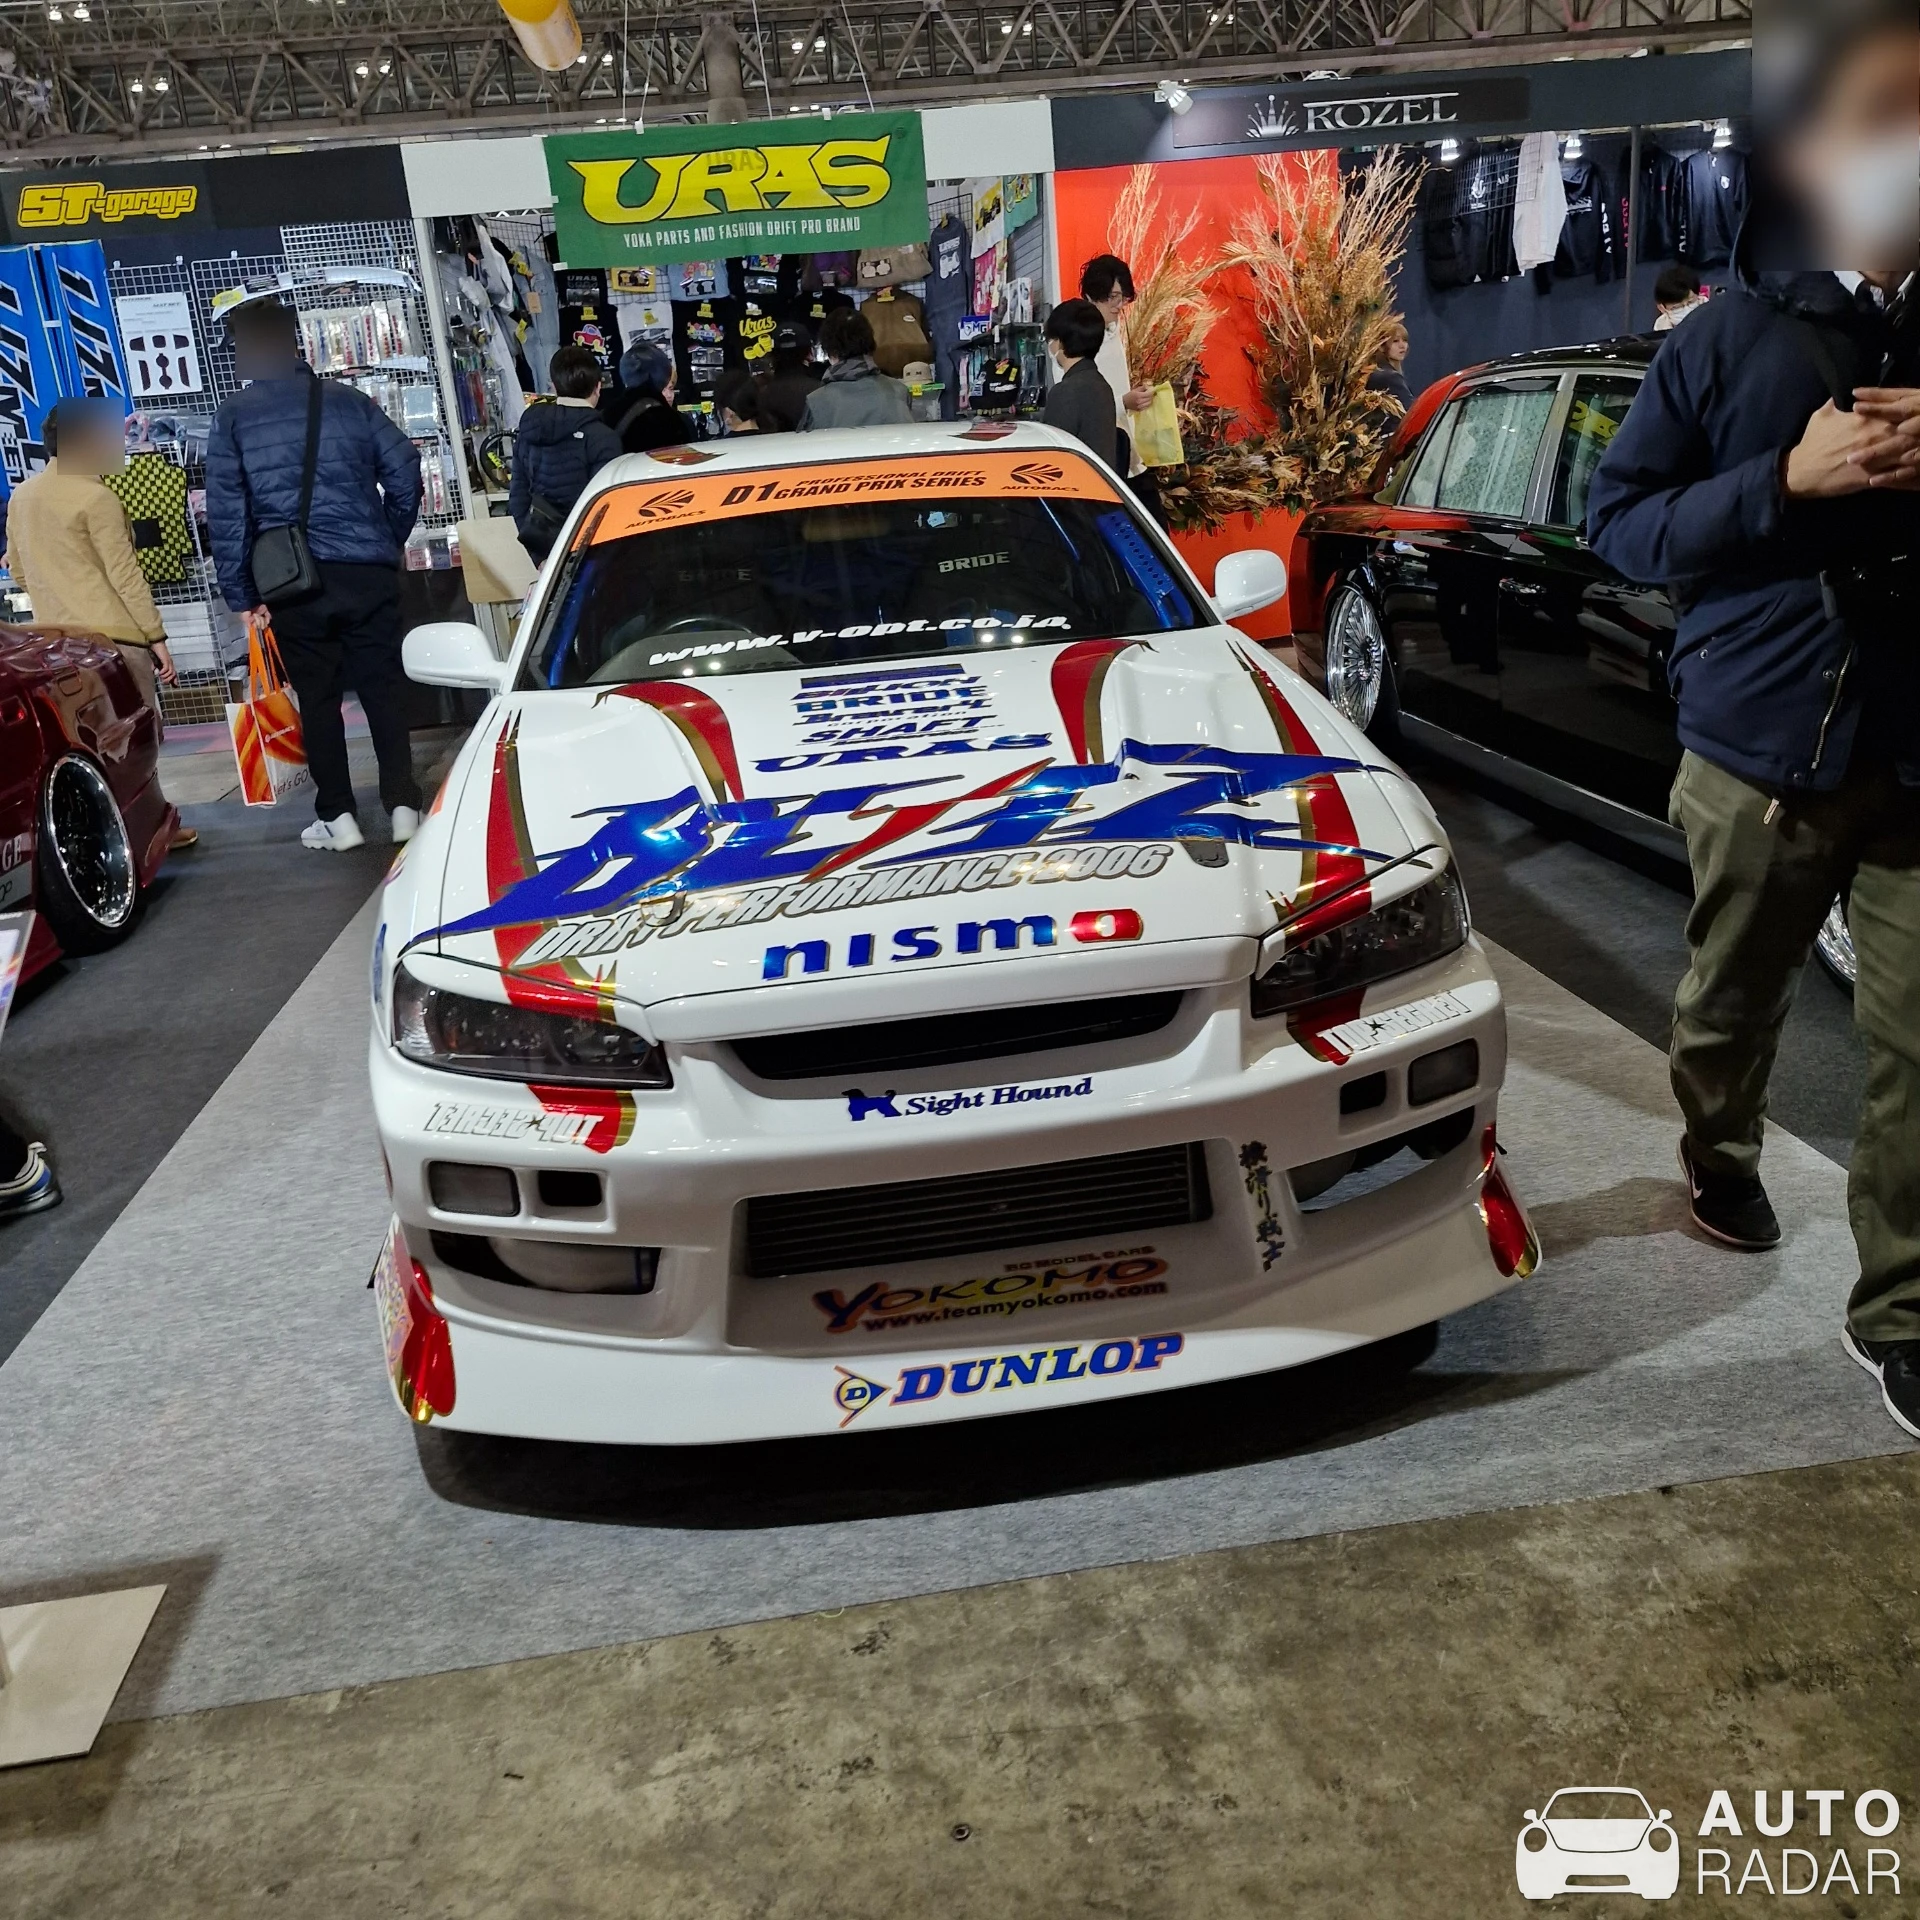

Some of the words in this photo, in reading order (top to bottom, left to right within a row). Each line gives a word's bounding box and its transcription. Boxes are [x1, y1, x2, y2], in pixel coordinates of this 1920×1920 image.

[1306, 94, 1458, 132] ROZEL
[567, 135, 894, 224] URAS
[18, 182, 198, 228] ST-garage
[623, 232, 653, 248] YOKA
[656, 229, 690, 246] PARTS
[694, 226, 716, 243] AND
[718, 222, 763, 240] FASHION
[766, 220, 797, 236] DRIFT
[801, 218, 822, 235] PRO
[826, 216, 861, 233] BRAND
[738, 315, 777, 339] Uras
[719, 481, 781, 507] D1
[773, 482, 851, 500] GRAND
[853, 477, 907, 493] PRIX
[910, 476, 988, 489] SERIES
[796, 470, 926, 487] PROFESSIONAL
[931, 469, 985, 478] DRIFT
[1000, 484, 1080, 493] AUTOBACS
[624, 509, 707, 530] AUTOBACS
[938, 551, 1011, 574] BRIDE
[791, 685, 988, 713] BRIDE
[801, 715, 999, 743] SHAFT
[749, 732, 1053, 773] URAS
[657, 850, 1040, 940] PERFORMANCE
[1025, 843, 1174, 884] 2006
[762, 908, 1144, 981] nismo
[905, 1091, 985, 1117] Sight
[991, 1076, 1094, 1106] Hound
[1101, 1245, 1155, 1260] CARS
[813, 1258, 1169, 1333] YOKOMO
[862, 1280, 1168, 1333] www.teamyokomo.com
[890, 1332, 1185, 1406] DUNLOP
